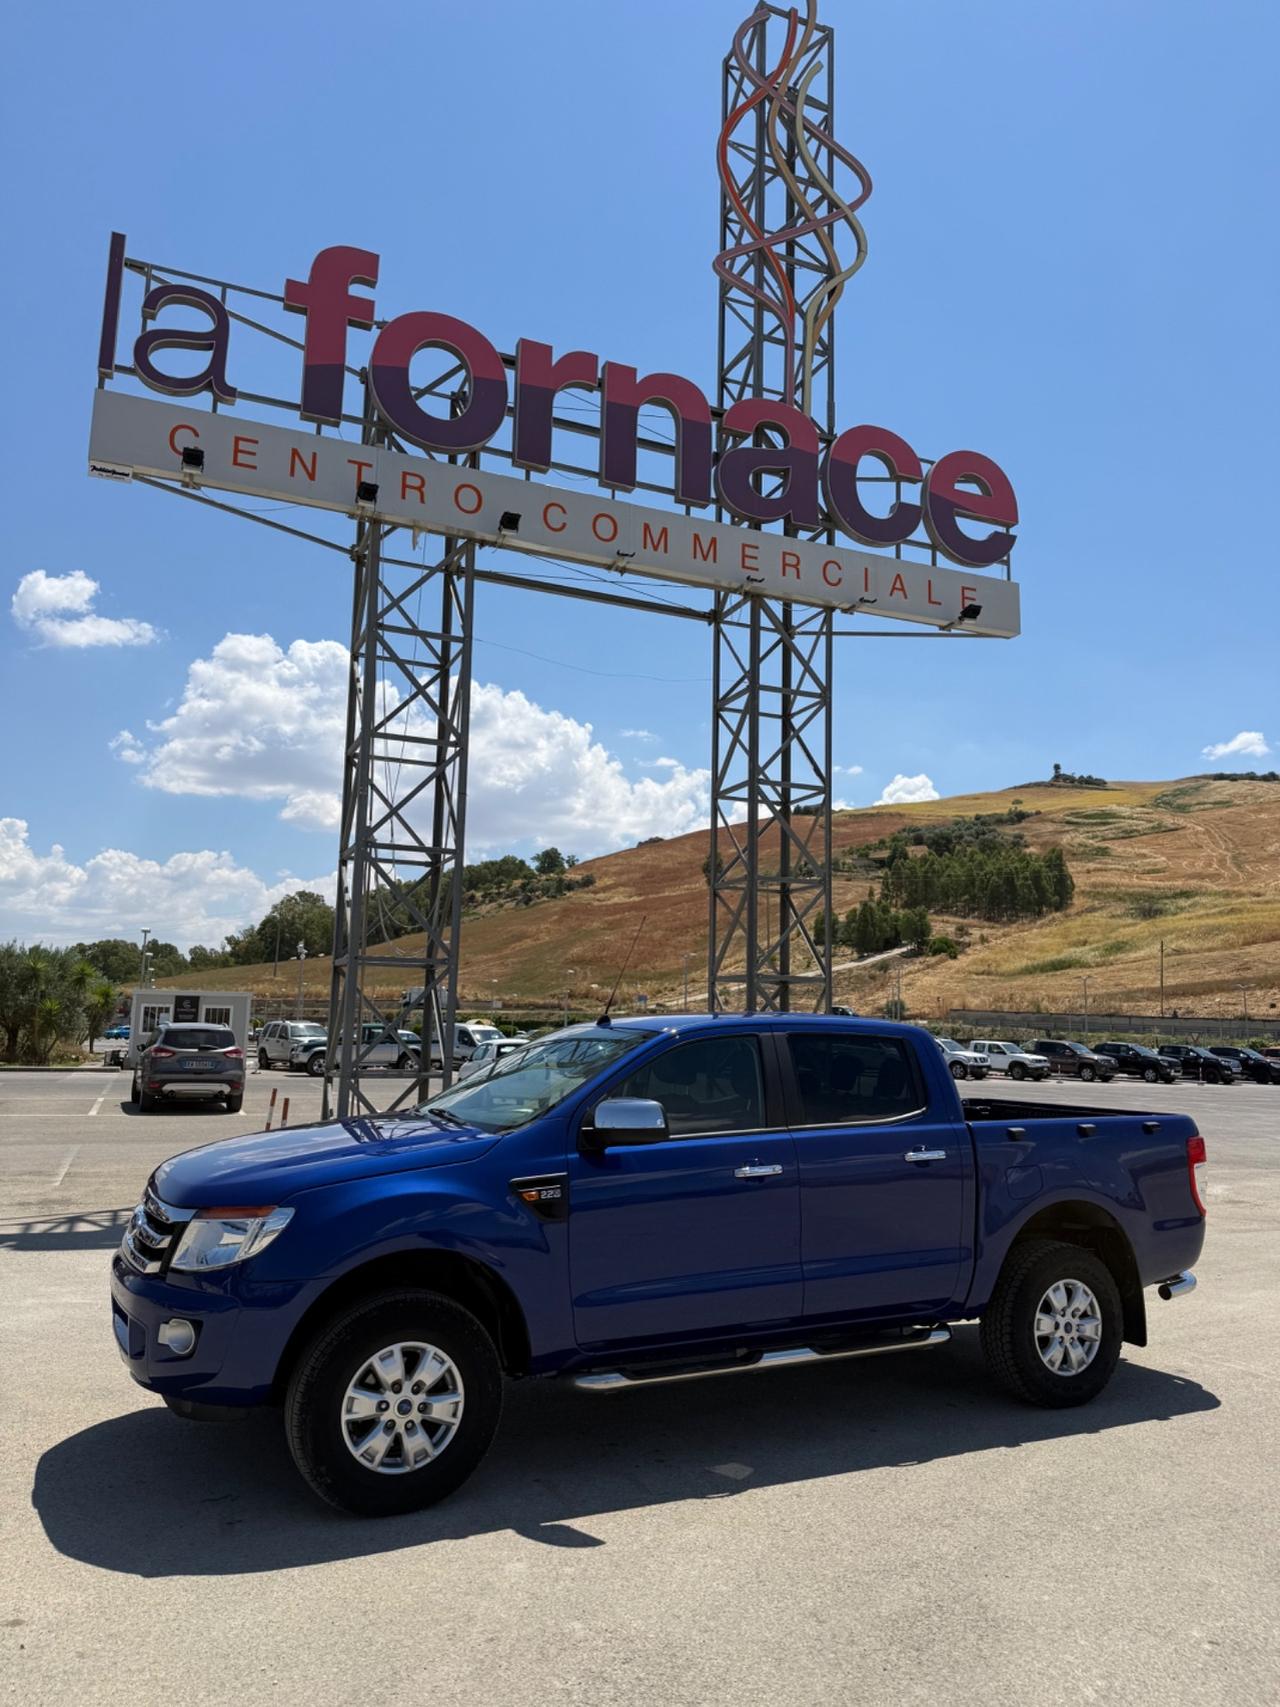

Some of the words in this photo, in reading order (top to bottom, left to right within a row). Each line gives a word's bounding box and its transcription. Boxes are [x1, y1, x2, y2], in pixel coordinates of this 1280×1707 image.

[99, 232, 237, 405] la
[284, 245, 1018, 568] fornace
[168, 424, 483, 514] CENTRO
[543, 502, 977, 607] COMMERCIALE
